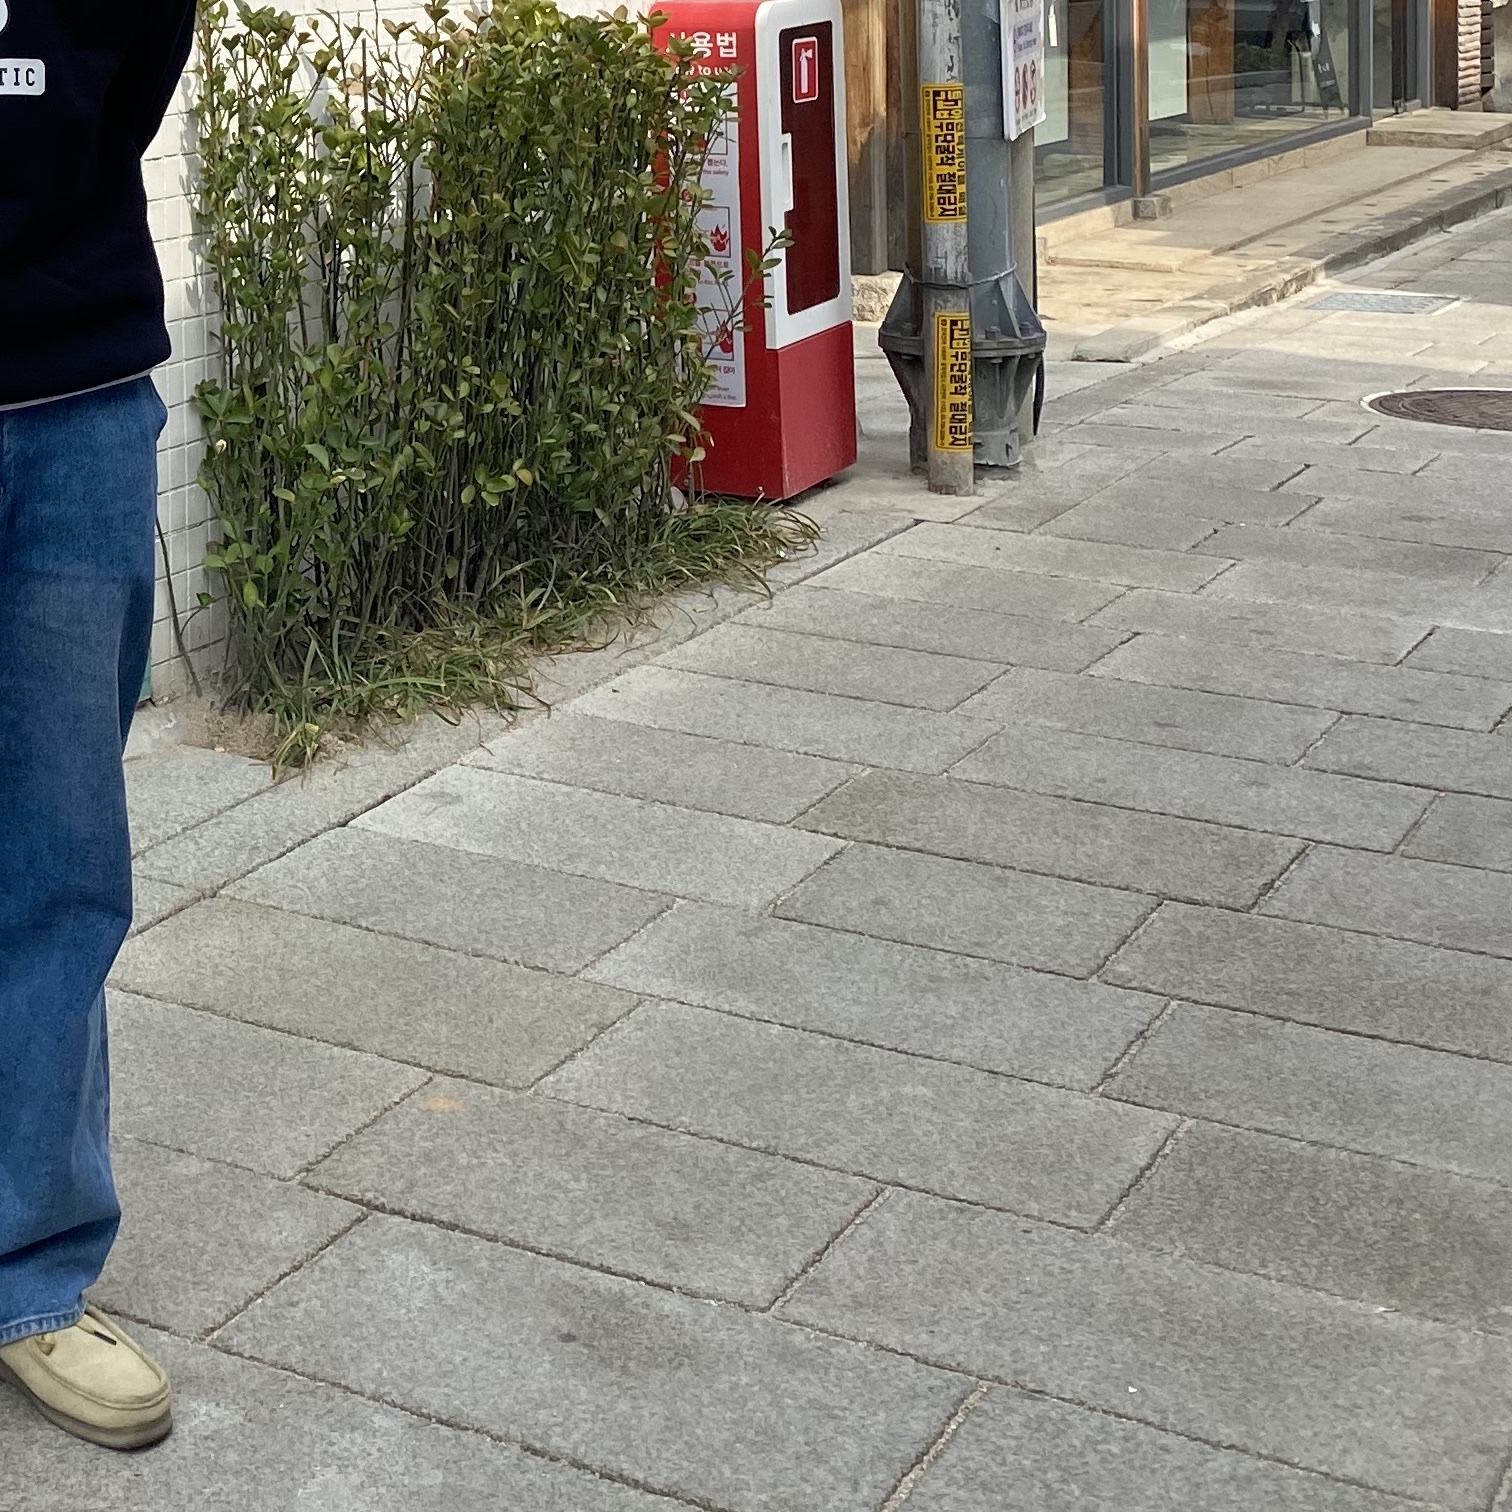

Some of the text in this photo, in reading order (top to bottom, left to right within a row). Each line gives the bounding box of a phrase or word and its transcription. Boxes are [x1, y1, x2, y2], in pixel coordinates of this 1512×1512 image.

[933, 90, 963, 120] 특고압
[935, 121, 958, 217] 무단굴착 절대금지
[948, 350, 967, 446] 무단굴착 절대금지
